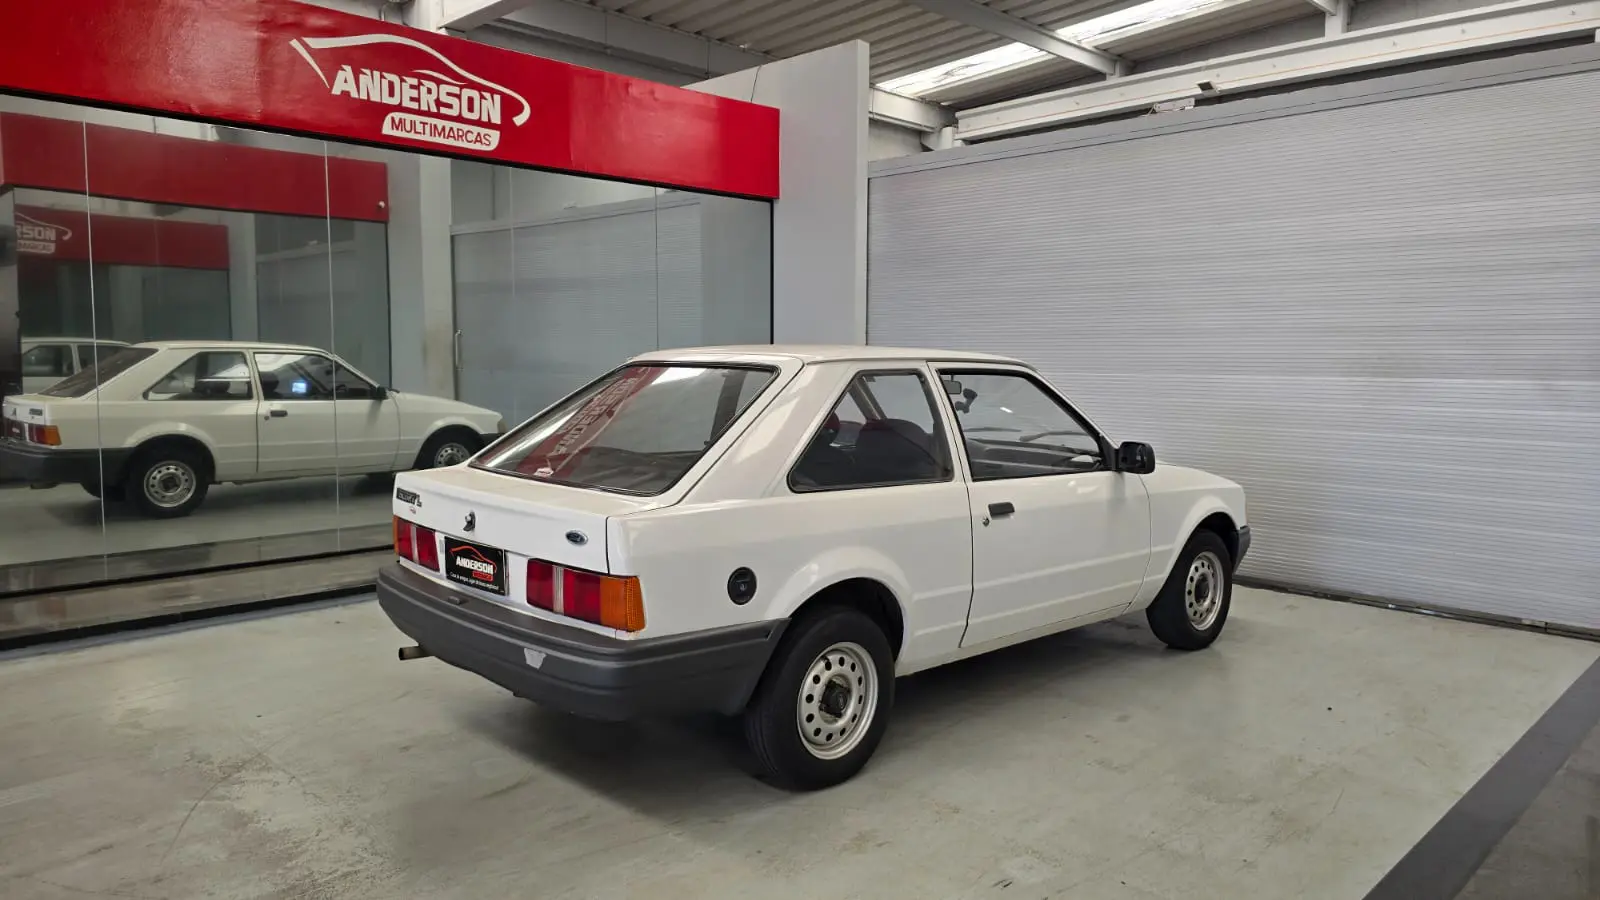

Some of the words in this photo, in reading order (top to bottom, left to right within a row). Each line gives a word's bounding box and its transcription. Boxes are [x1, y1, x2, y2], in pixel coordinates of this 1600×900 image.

[331, 64, 502, 125] ANDERSON
[390, 115, 493, 147] MULTIMARCAS
[455, 555, 494, 576] ANDERSON
